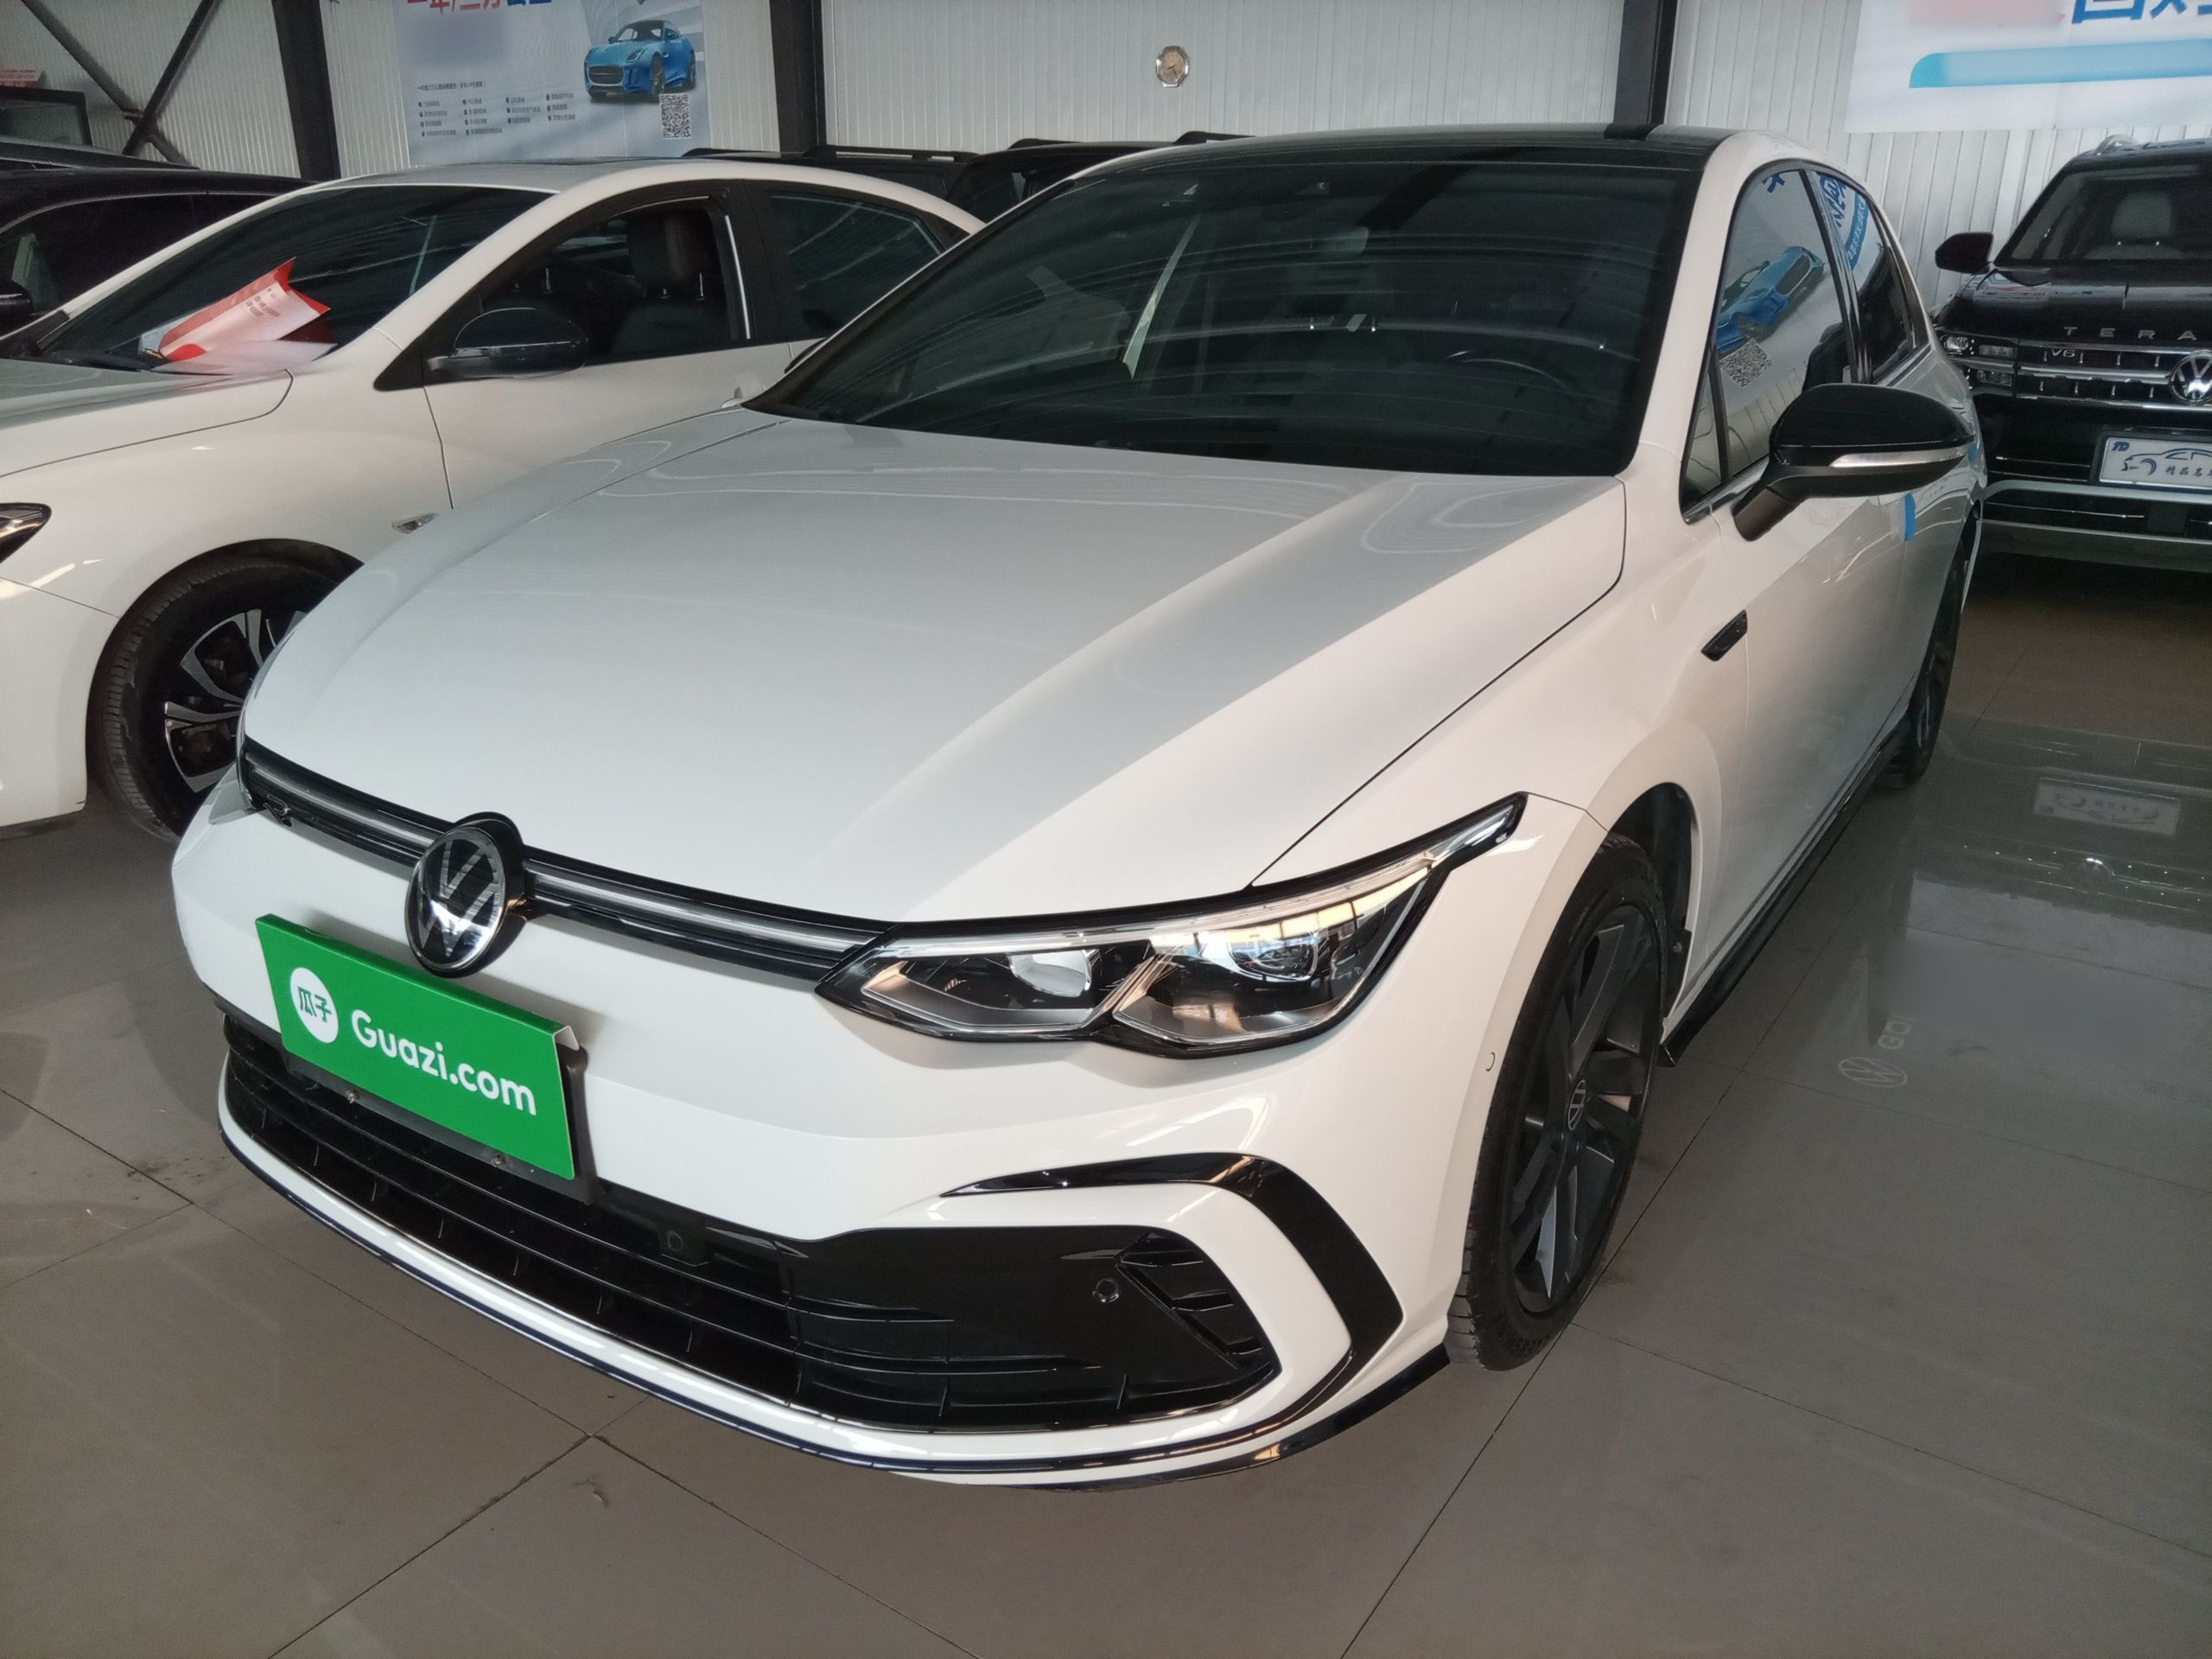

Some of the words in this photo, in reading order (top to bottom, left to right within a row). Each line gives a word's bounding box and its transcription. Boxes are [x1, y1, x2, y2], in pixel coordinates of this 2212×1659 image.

[2063, 326, 2198, 341] TERA
[2050, 348, 2075, 359] V6
[296, 986, 333, 1024] 瓜子
[350, 1009, 537, 1116] Guazi.com
